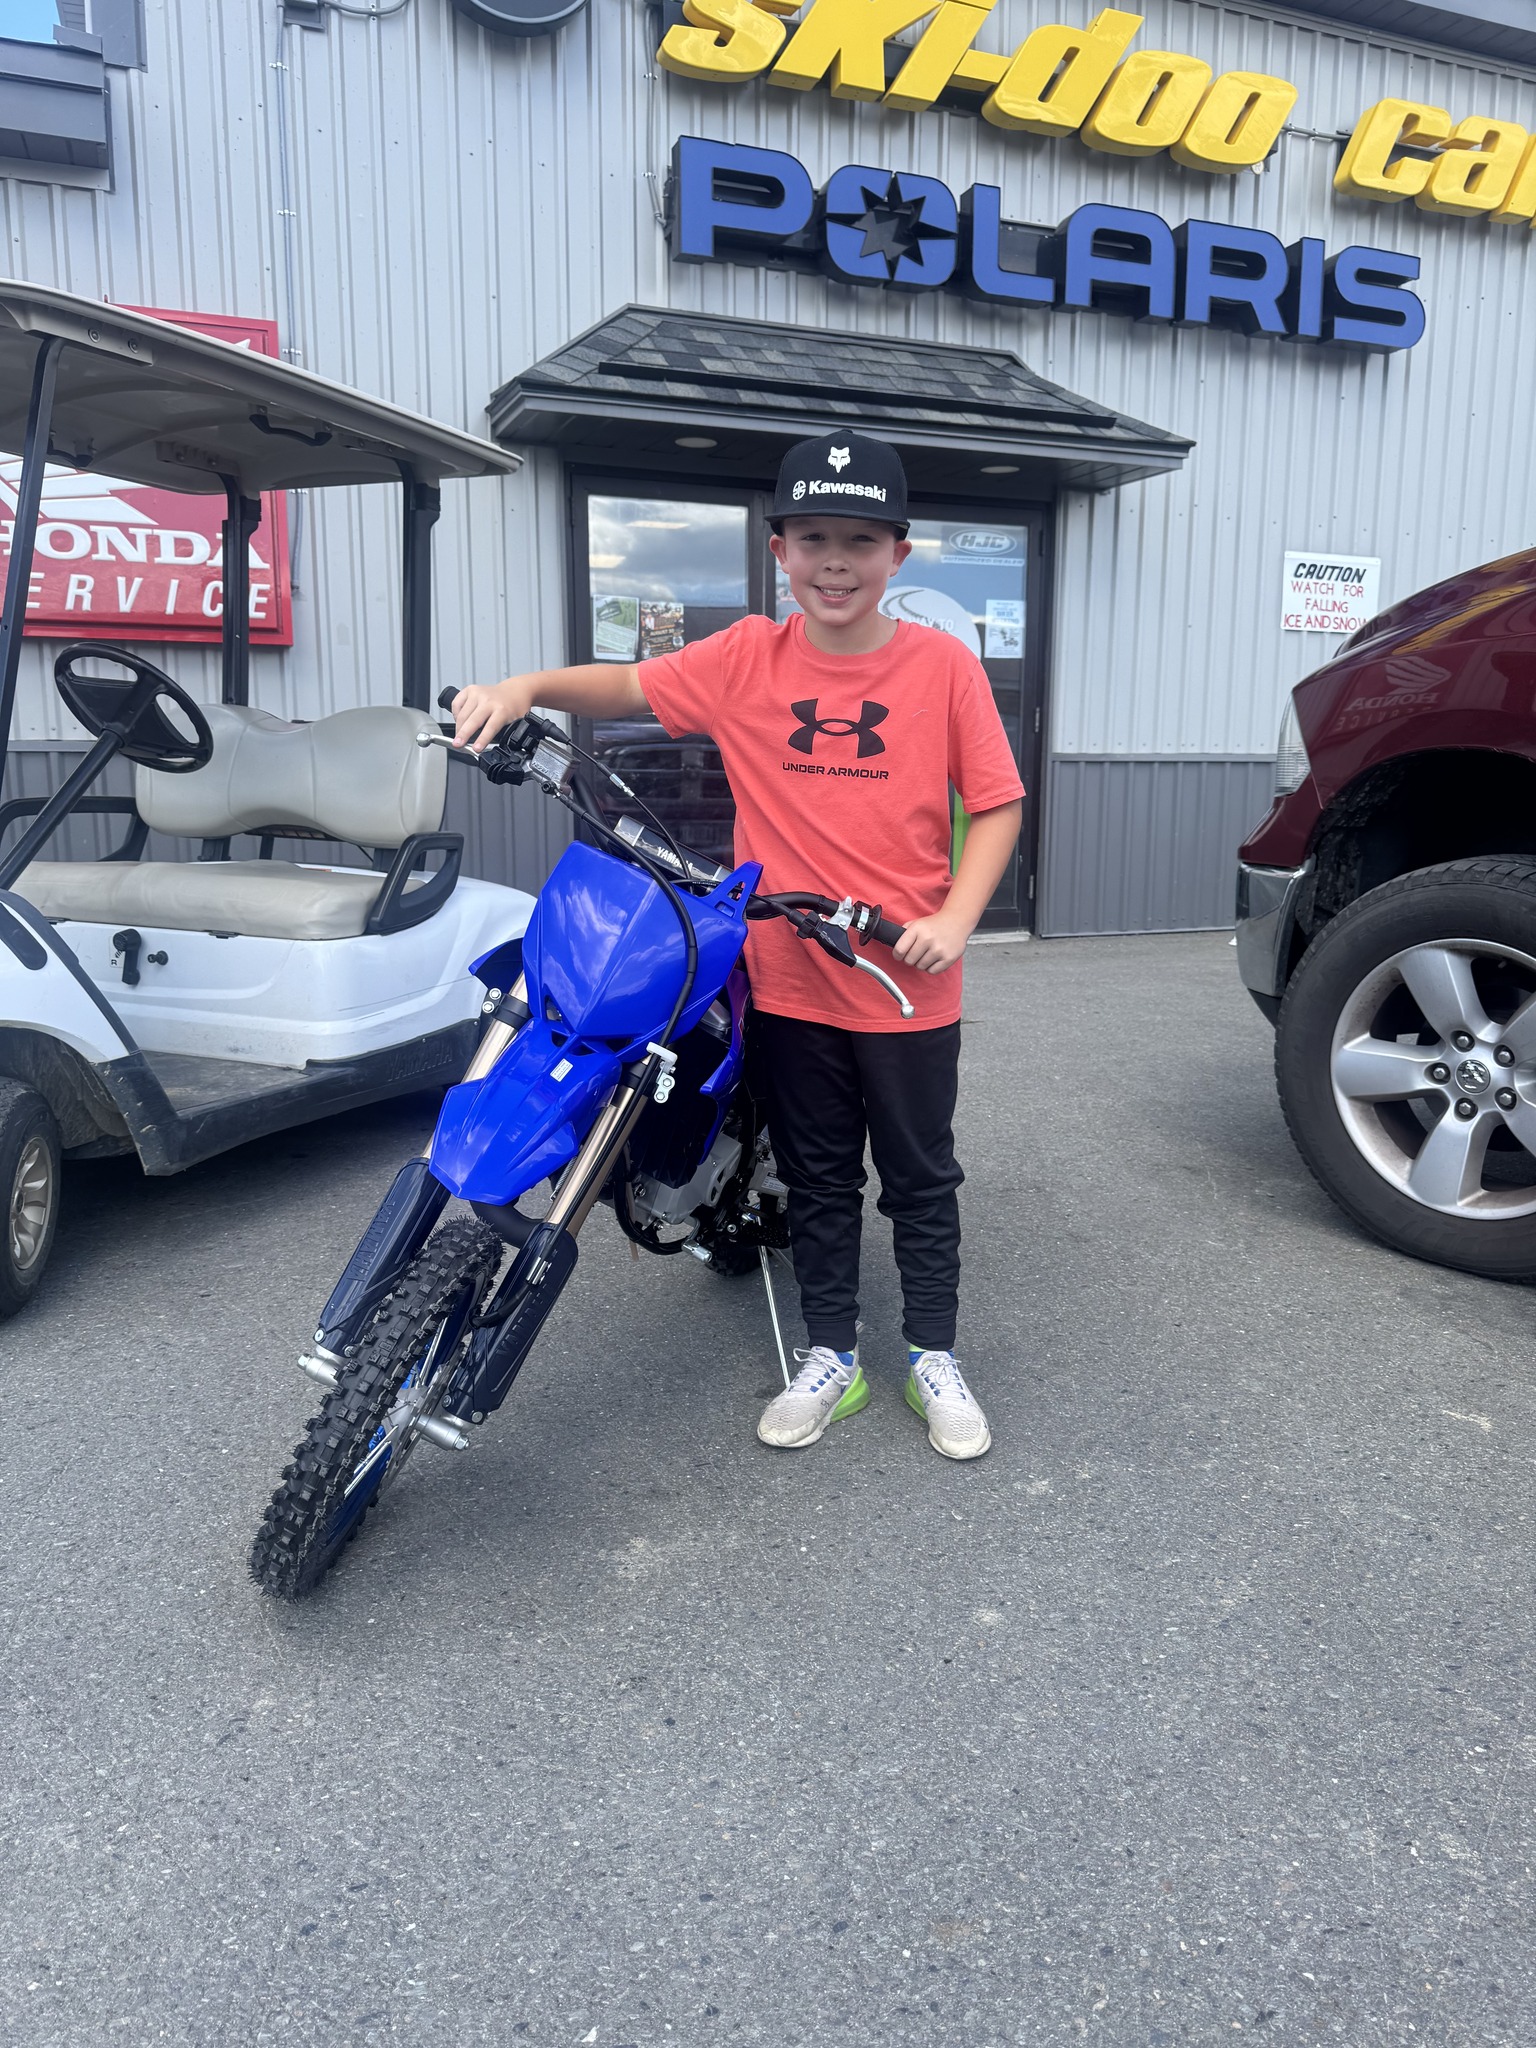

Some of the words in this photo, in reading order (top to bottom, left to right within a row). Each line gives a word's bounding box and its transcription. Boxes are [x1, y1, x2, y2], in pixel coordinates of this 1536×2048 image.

[674, 135, 1425, 353] POLARIS
[808, 480, 887, 502] Kawasaki
[0, 520, 271, 570] ONDA
[960, 535, 1005, 549] HJC
[1294, 562, 1367, 584] CAUTION
[25, 571, 271, 619] ERVICE
[1291, 580, 1335, 595] WATCH
[1343, 584, 1364, 598] FOR
[1305, 598, 1349, 613] FALLING
[1284, 614, 1302, 628] ICE
[1304, 615, 1331, 629] AND
[782, 762, 825, 775] UNDER
[827, 767, 889, 780] ARMOUR
[656, 847, 694, 872] YAMAA
